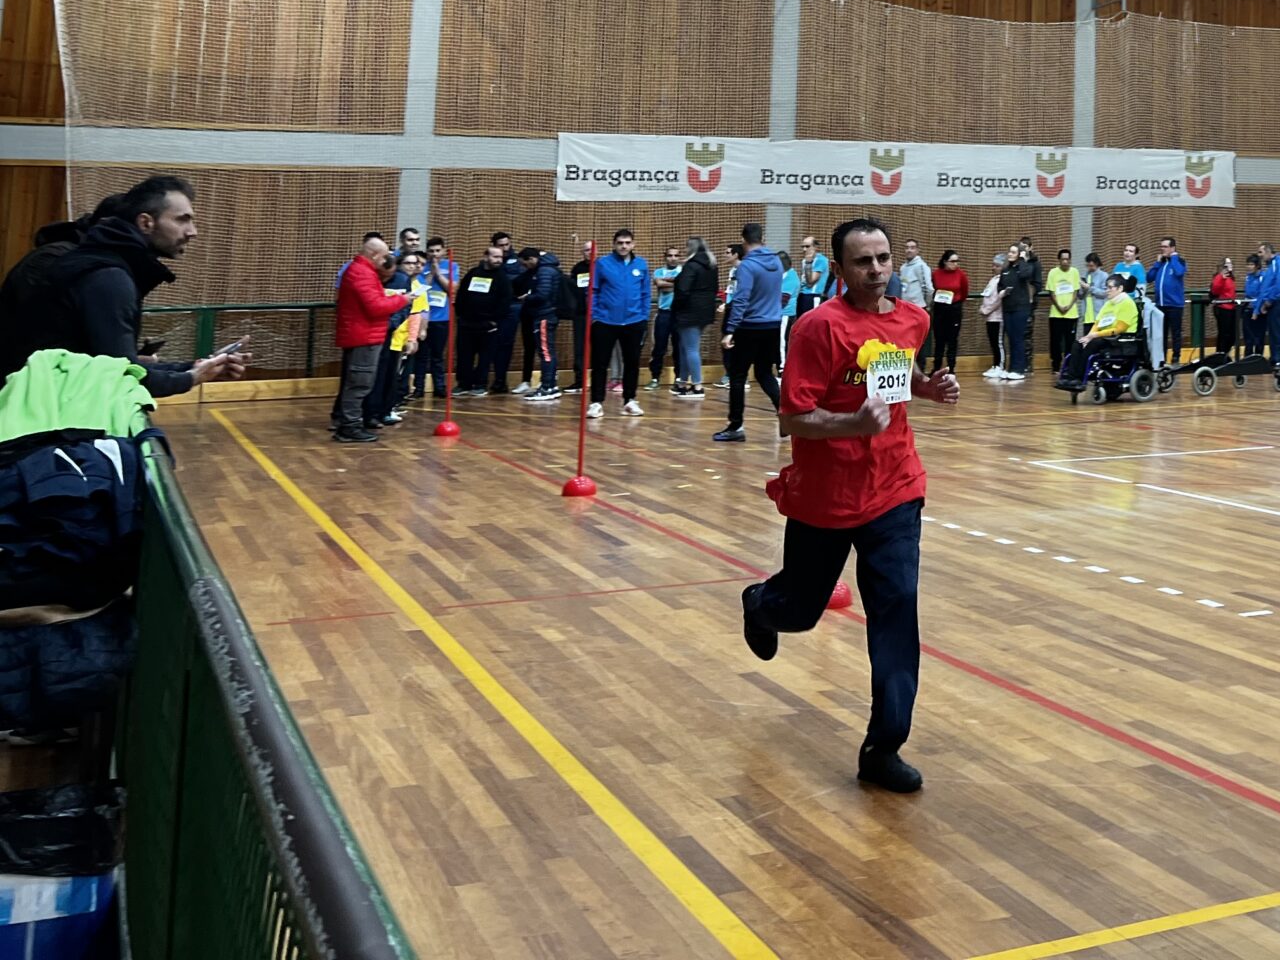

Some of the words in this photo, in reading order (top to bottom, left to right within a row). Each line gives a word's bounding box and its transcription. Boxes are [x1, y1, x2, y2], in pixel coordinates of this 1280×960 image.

[564, 164, 679, 187] Bragança
[760, 169, 864, 191] Bragança
[937, 173, 1030, 193] Bragança
[1096, 176, 1180, 194] Bragança
[879, 351, 907, 360] MEGA
[878, 373, 906, 390] 2013
